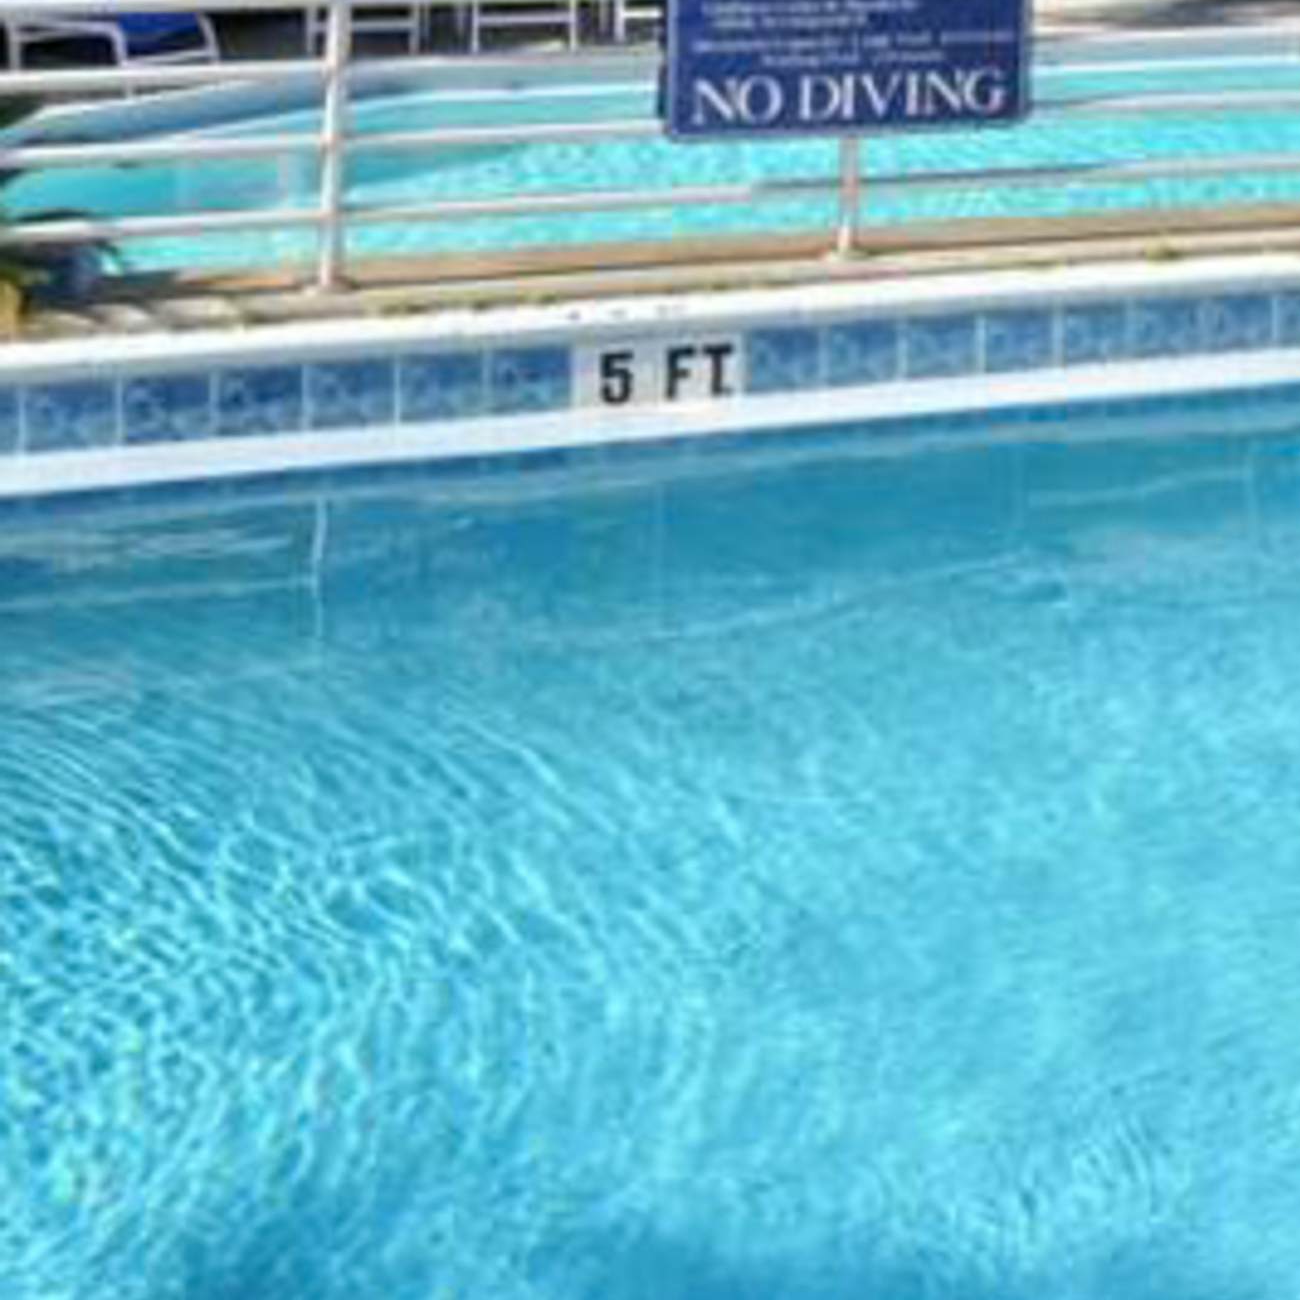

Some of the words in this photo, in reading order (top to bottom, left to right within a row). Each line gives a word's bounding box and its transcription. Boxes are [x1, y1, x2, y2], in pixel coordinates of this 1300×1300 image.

[691, 73, 783, 125] NO
[799, 66, 1006, 120] DIVING
[601, 350, 634, 406] 5
